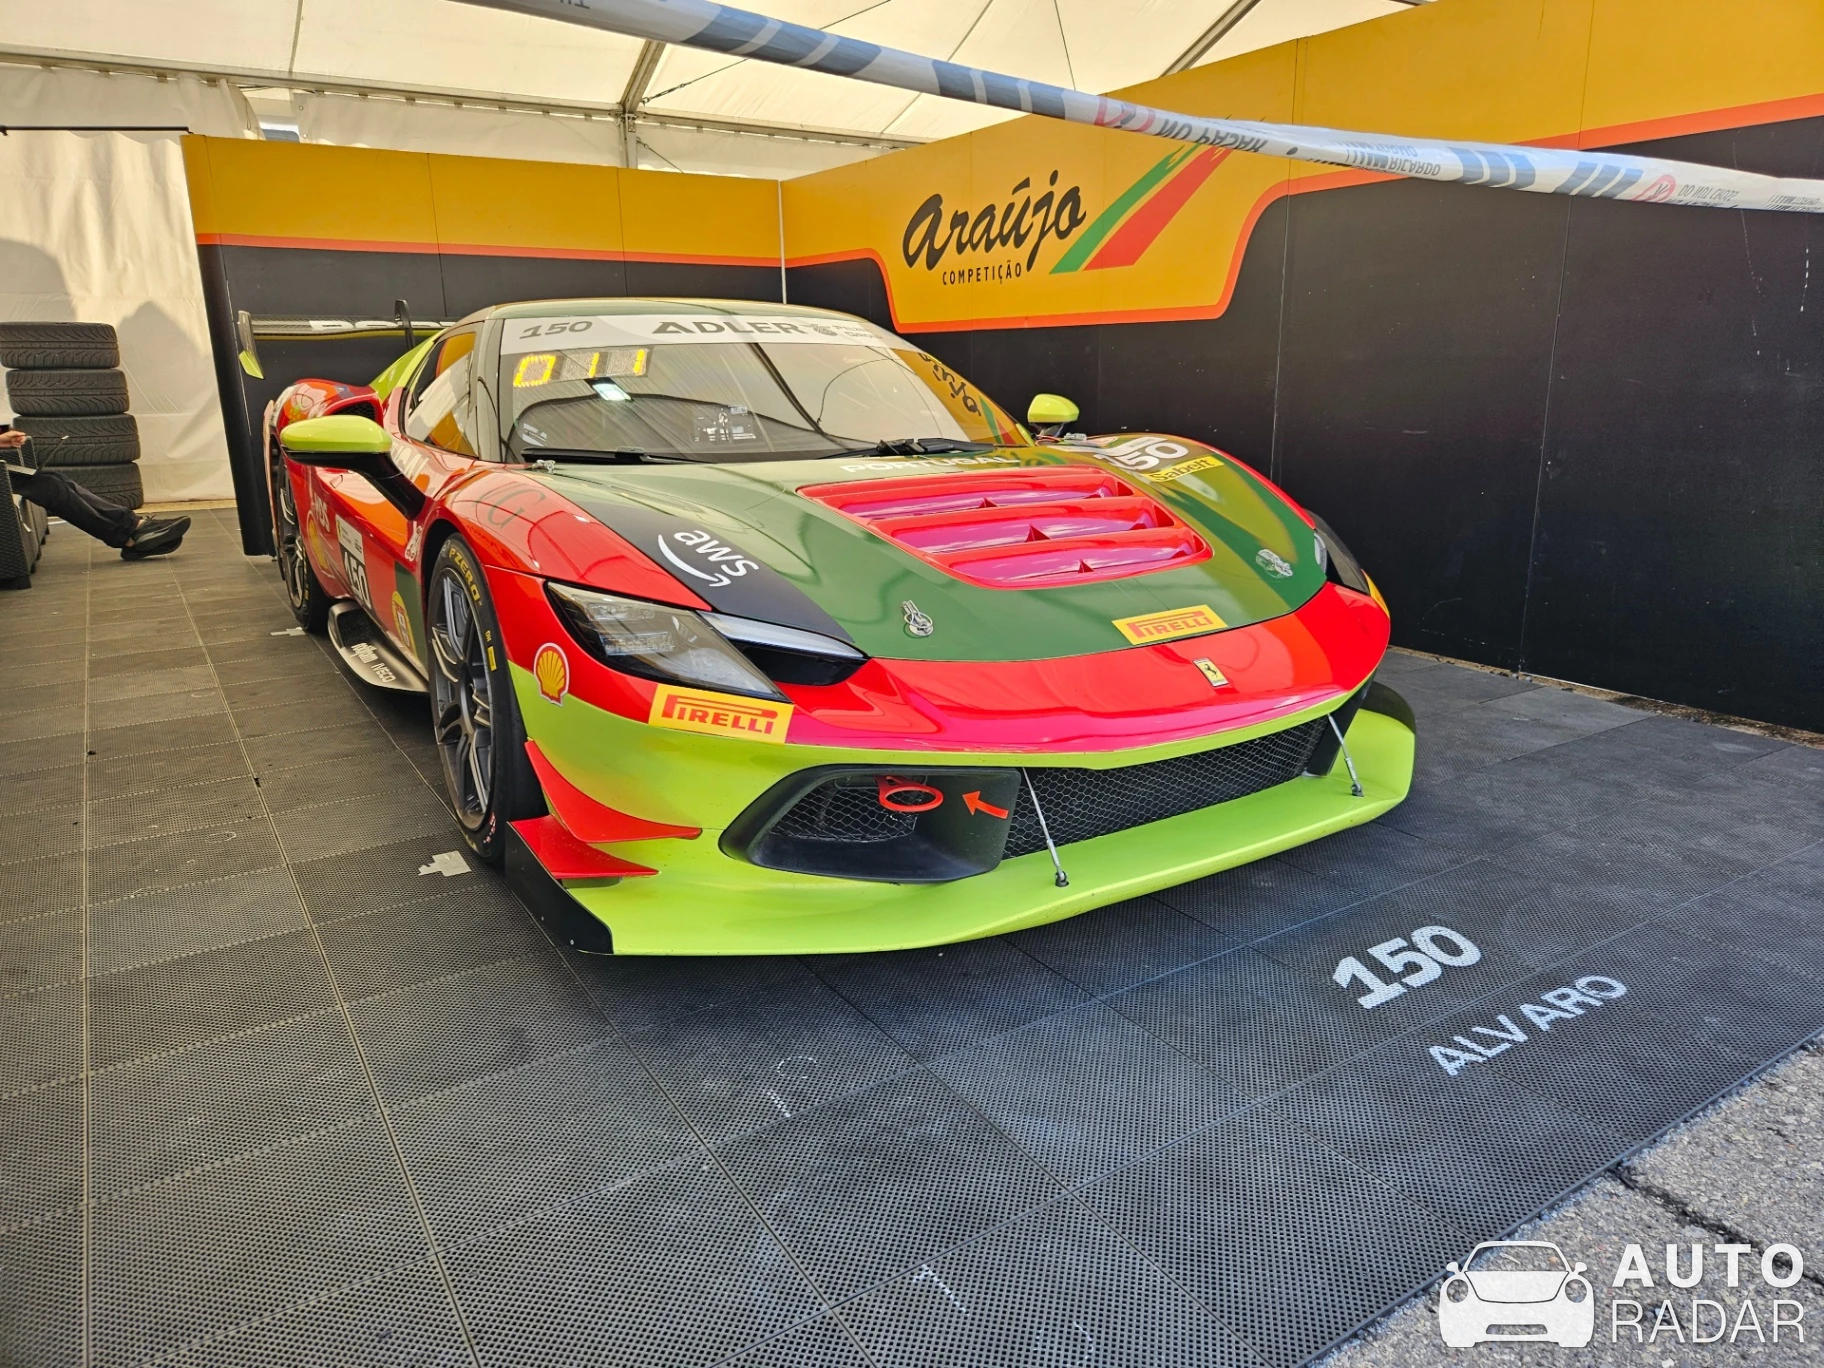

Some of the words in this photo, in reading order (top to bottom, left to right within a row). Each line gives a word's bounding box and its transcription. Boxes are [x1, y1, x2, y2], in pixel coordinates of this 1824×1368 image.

[942, 259, 1022, 285] COMPETIÇÃO
[519, 320, 593, 339] 150
[652, 321, 808, 335] ADLER
[839, 455, 1021, 473] PORTUGAL
[1150, 458, 1215, 482] Sabelt
[673, 529, 760, 577] aws
[343, 551, 373, 610] 150
[1126, 610, 1214, 639] PIRELLI
[661, 693, 778, 735] PIRELLI
[1332, 925, 1481, 1010] 150
[1429, 975, 1628, 1076] ALVARO
